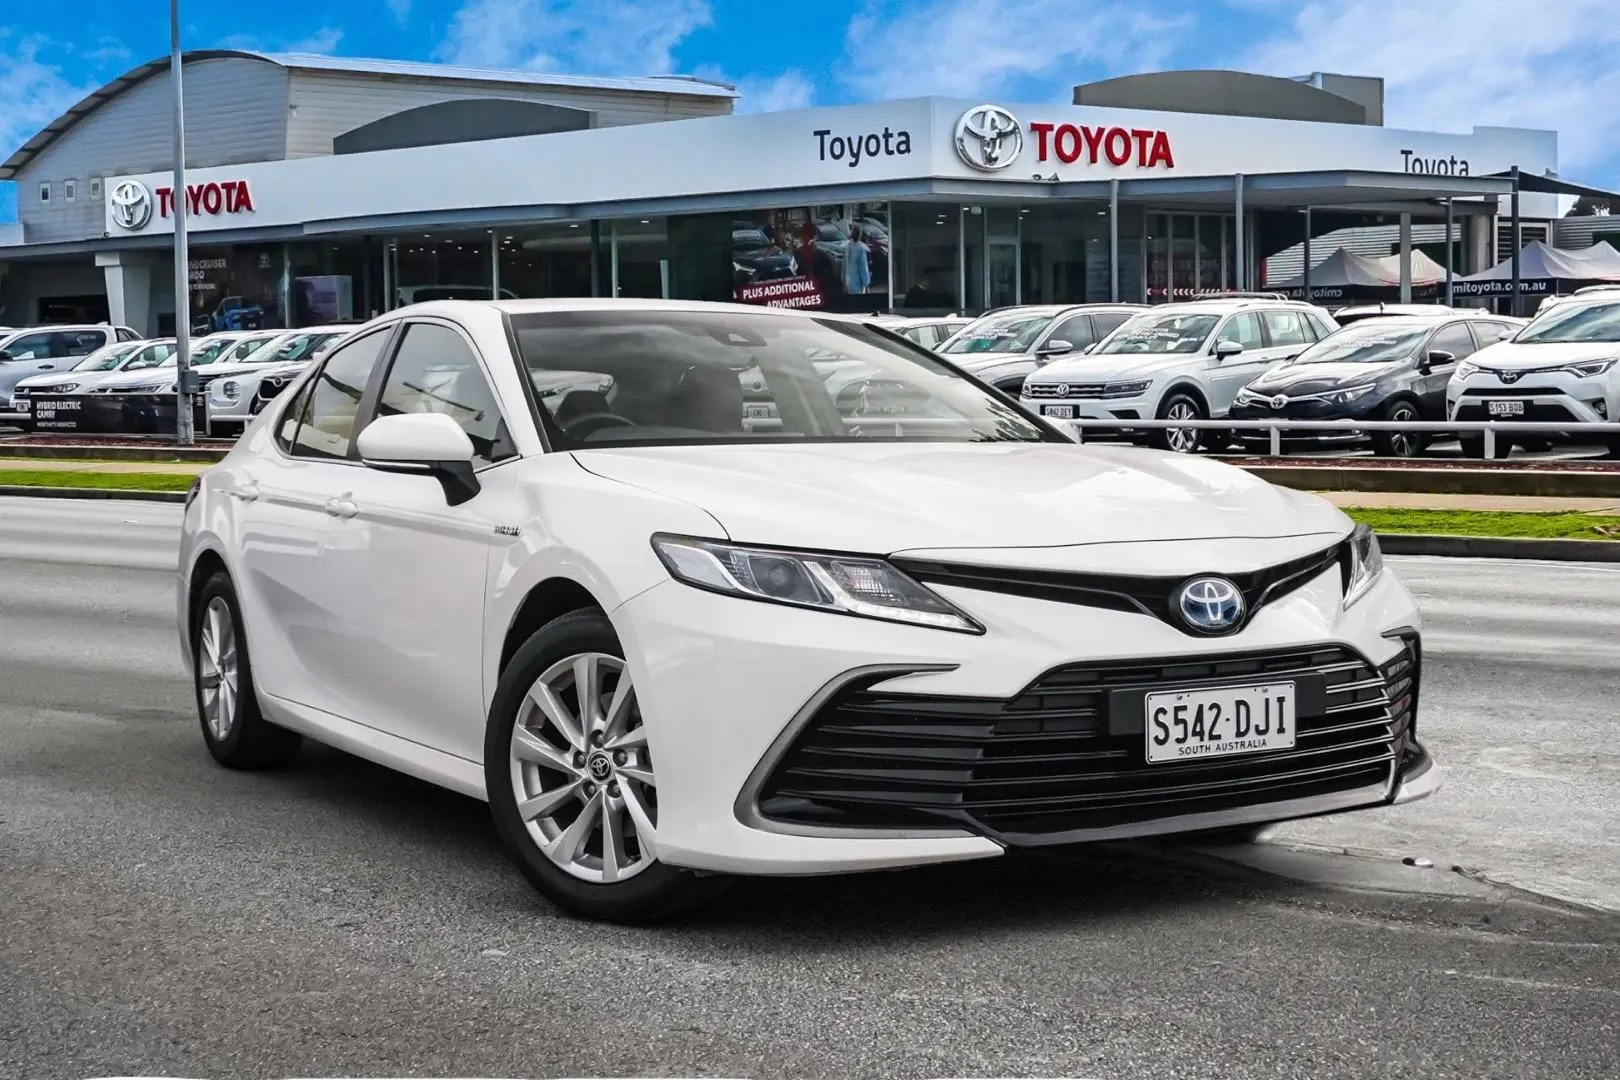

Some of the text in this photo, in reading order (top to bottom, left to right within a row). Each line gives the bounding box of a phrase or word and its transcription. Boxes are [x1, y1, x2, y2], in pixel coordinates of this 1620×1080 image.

[813, 126, 912, 168] Toyota
[1030, 122, 1175, 169] TOYOTA
[743, 287, 763, 299] PLUS
[764, 280, 816, 297] ADDITIONAL
[1453, 281, 1547, 295] mitoyota.cm.au
[767, 294, 821, 309] ADVANTAGES
[1179, 738, 1267, 755] SOUTH AUSTRALIA
